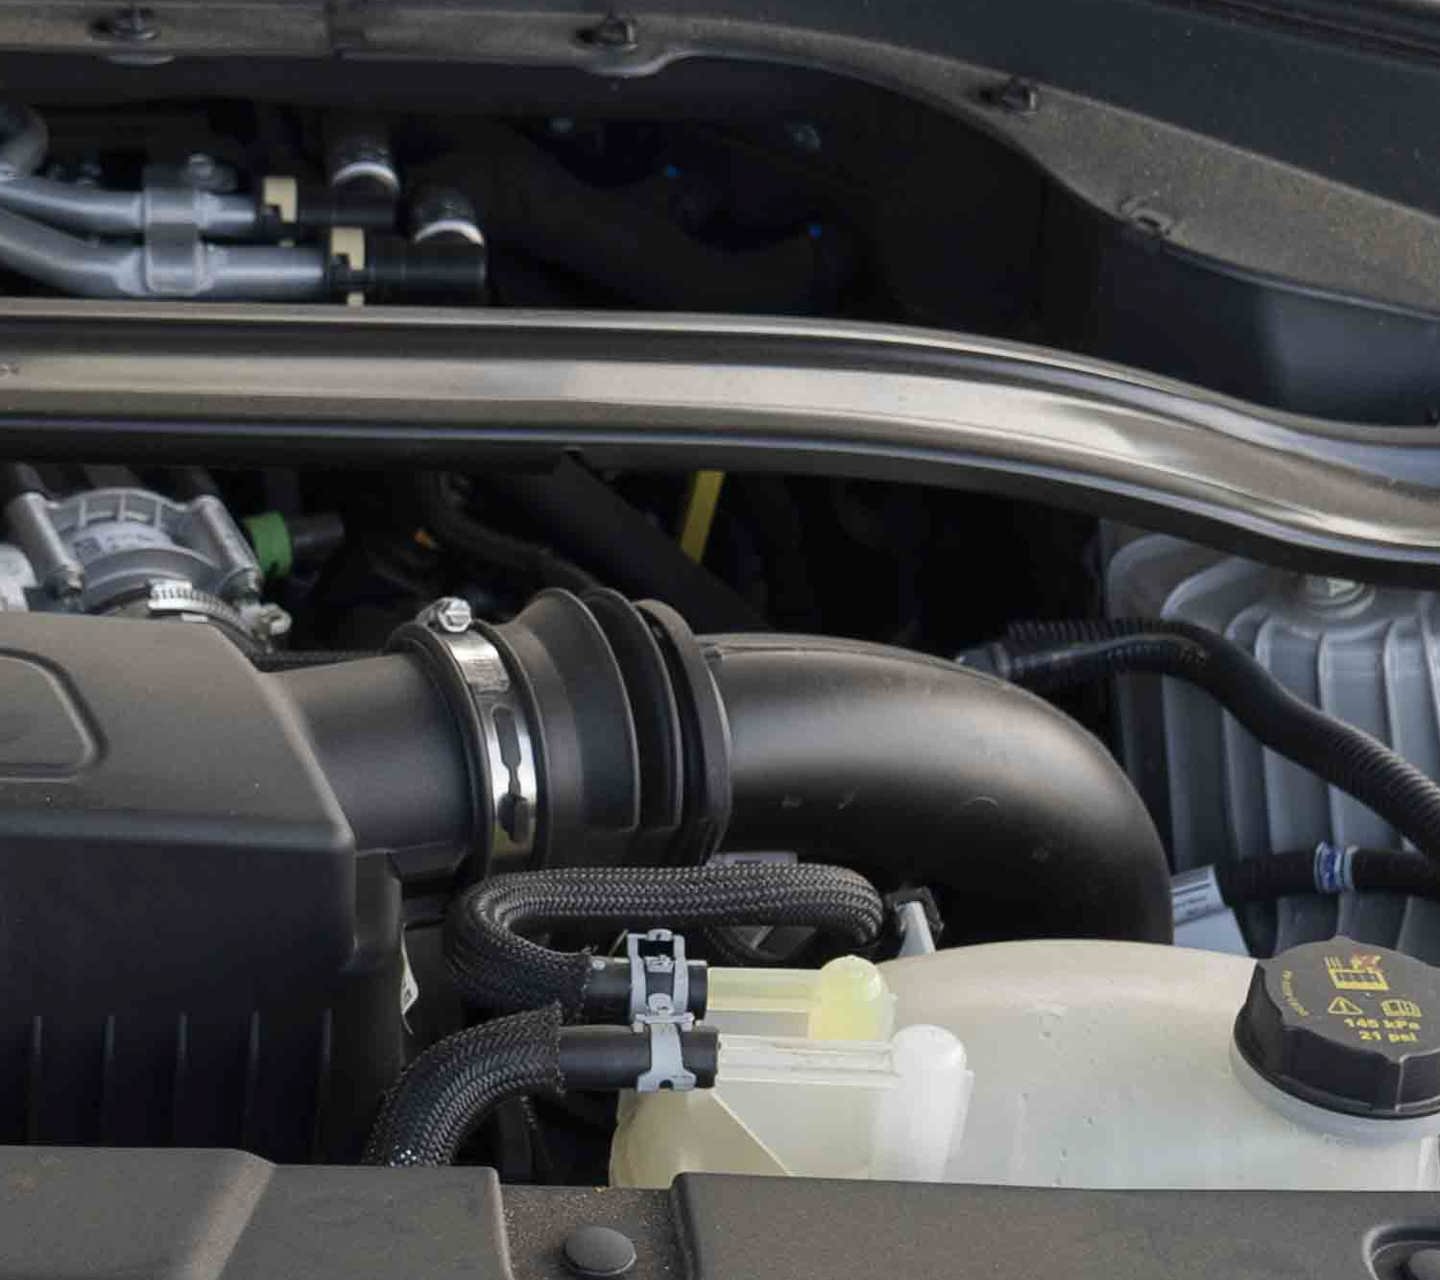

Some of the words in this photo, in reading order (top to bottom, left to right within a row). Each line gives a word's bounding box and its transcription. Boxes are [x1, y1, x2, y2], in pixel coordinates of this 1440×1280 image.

[1382, 1019, 1421, 1030] kPa
[1358, 1031, 1382, 1041] 21
[1386, 1032, 1418, 1043] psi
